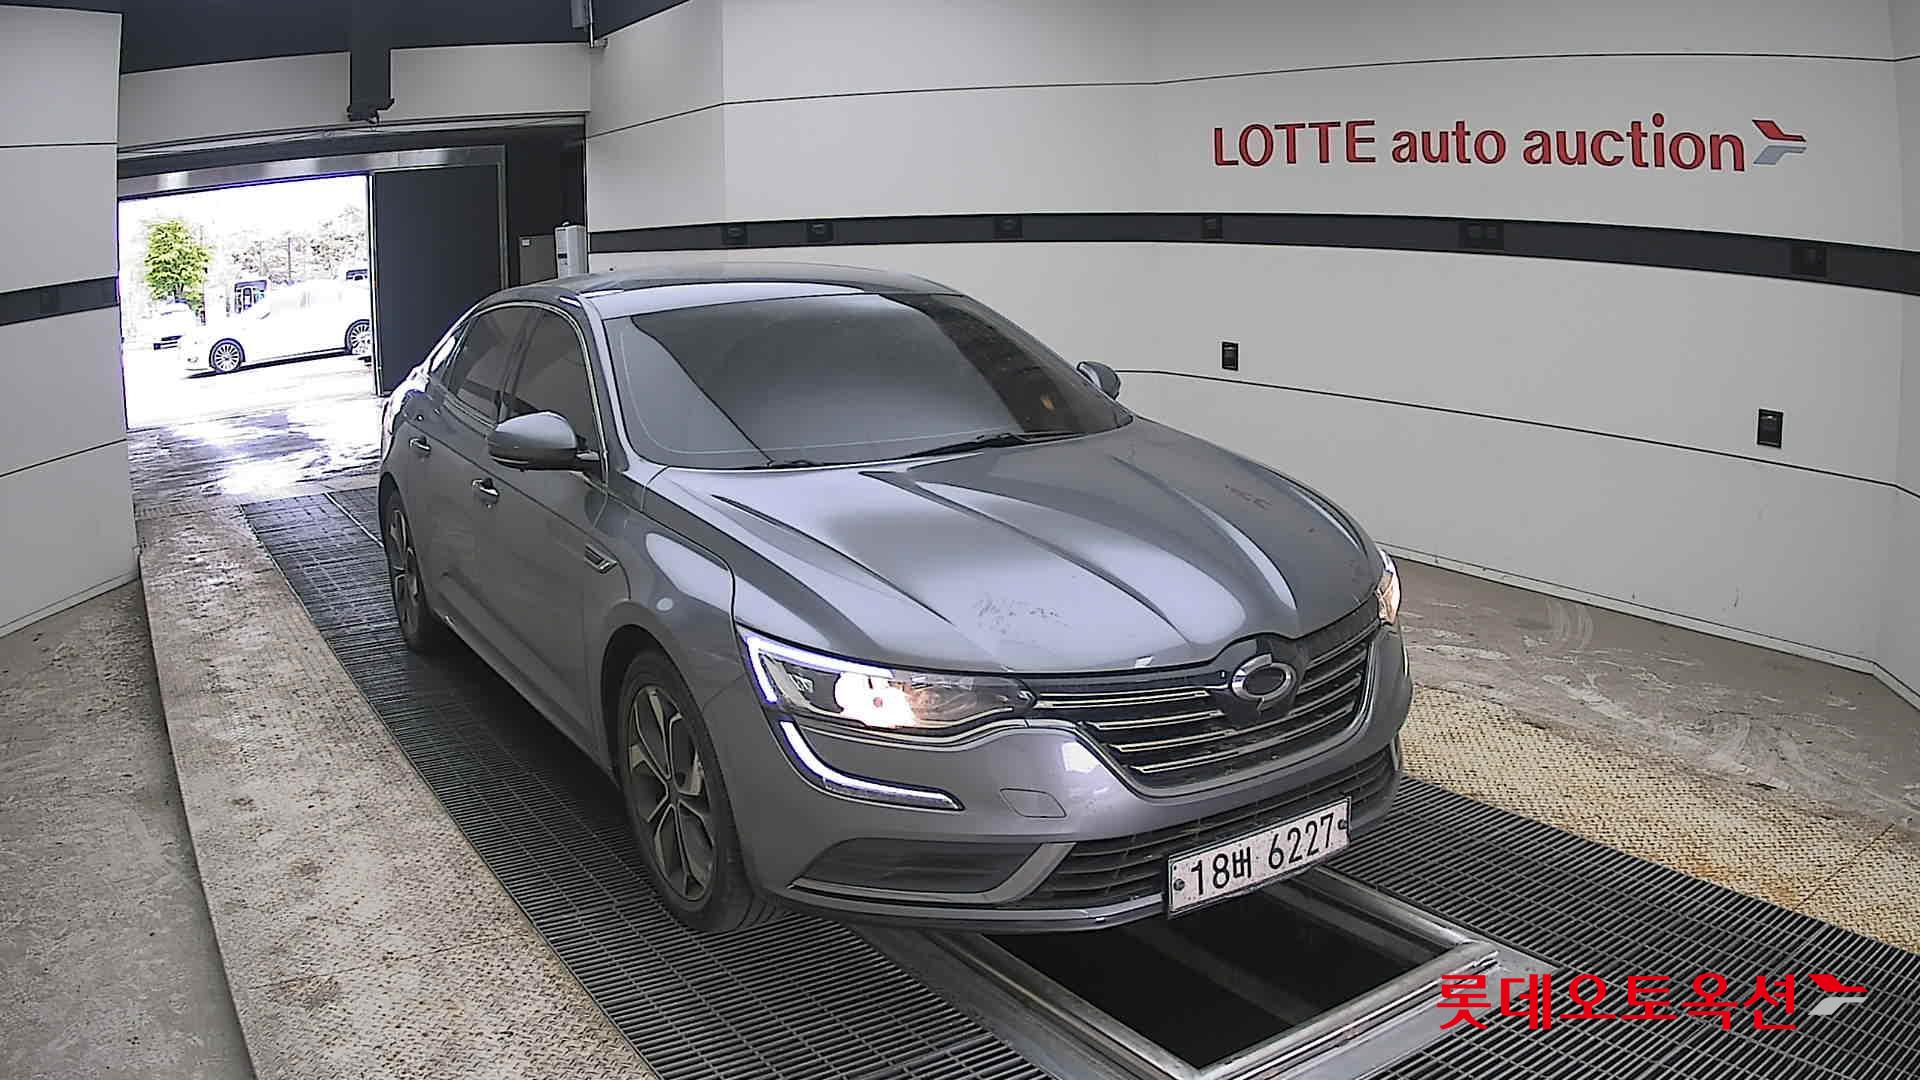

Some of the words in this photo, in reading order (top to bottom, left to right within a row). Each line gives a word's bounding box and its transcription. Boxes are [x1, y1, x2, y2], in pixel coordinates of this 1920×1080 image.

[1213, 120, 1376, 167] LOTTE
[1391, 121, 1506, 165] auto
[1522, 113, 1745, 171] auction
[1191, 846, 1252, 895] 18버
[1268, 812, 1334, 869] 6227
